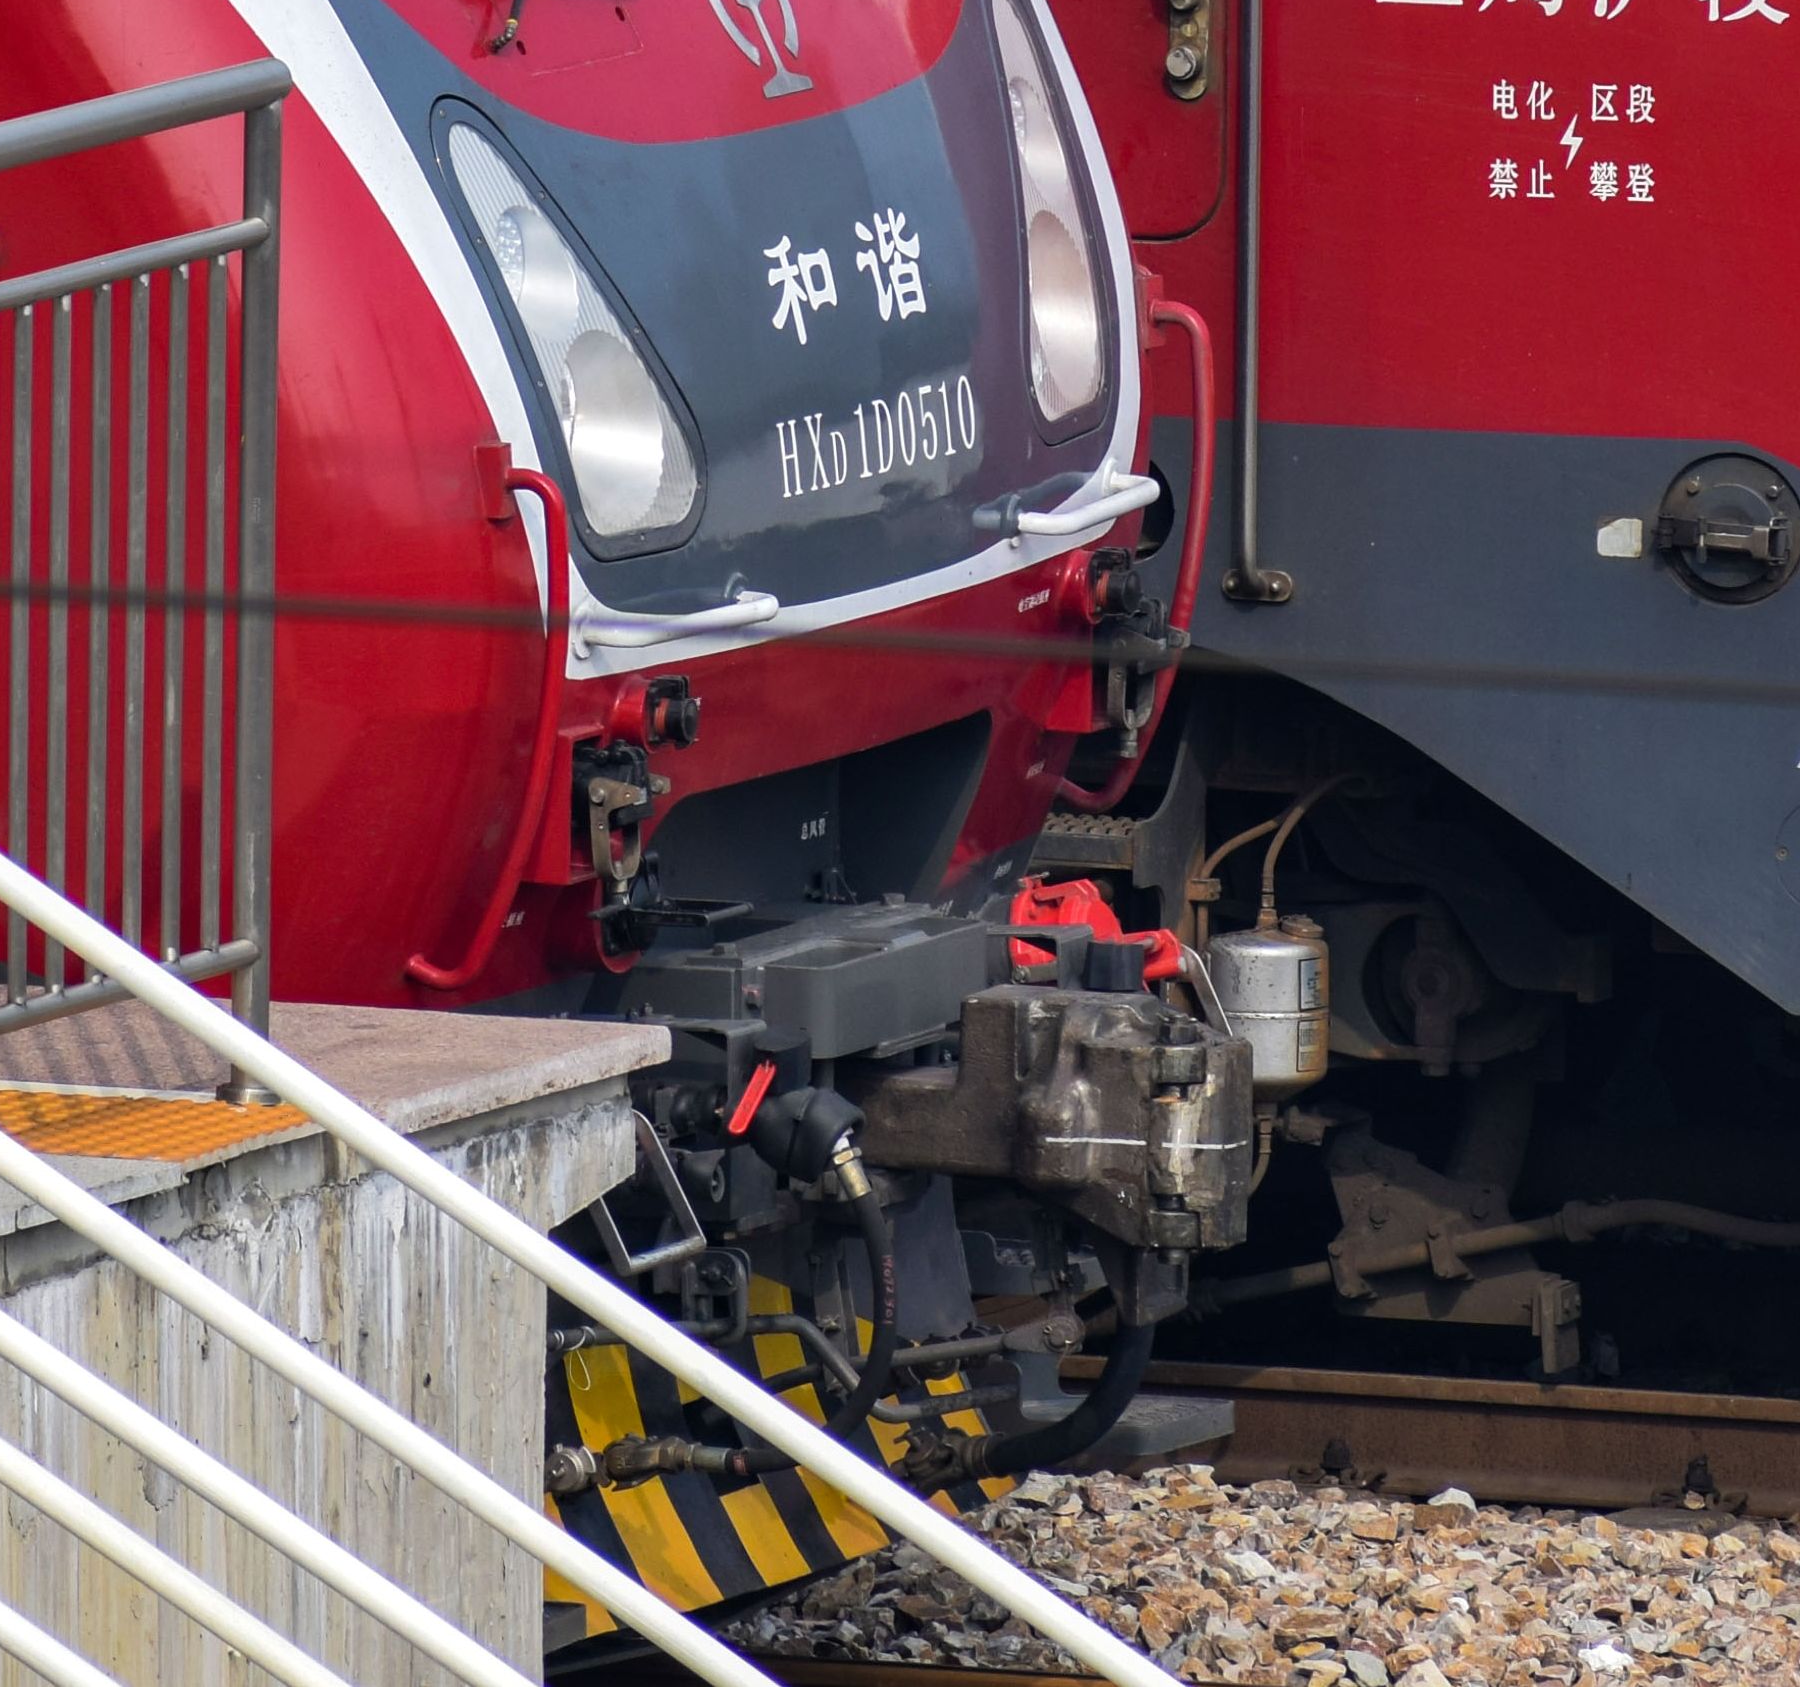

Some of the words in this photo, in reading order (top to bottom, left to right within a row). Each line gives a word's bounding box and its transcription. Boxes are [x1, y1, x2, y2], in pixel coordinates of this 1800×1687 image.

[1492, 78, 1556, 121] 电化
[1590, 83, 1656, 124] 区段
[1488, 158, 1555, 200] 禁止
[1589, 161, 1655, 203] 攀登
[763, 207, 927, 345] 和谐
[775, 374, 976, 499] HXD1D0510
